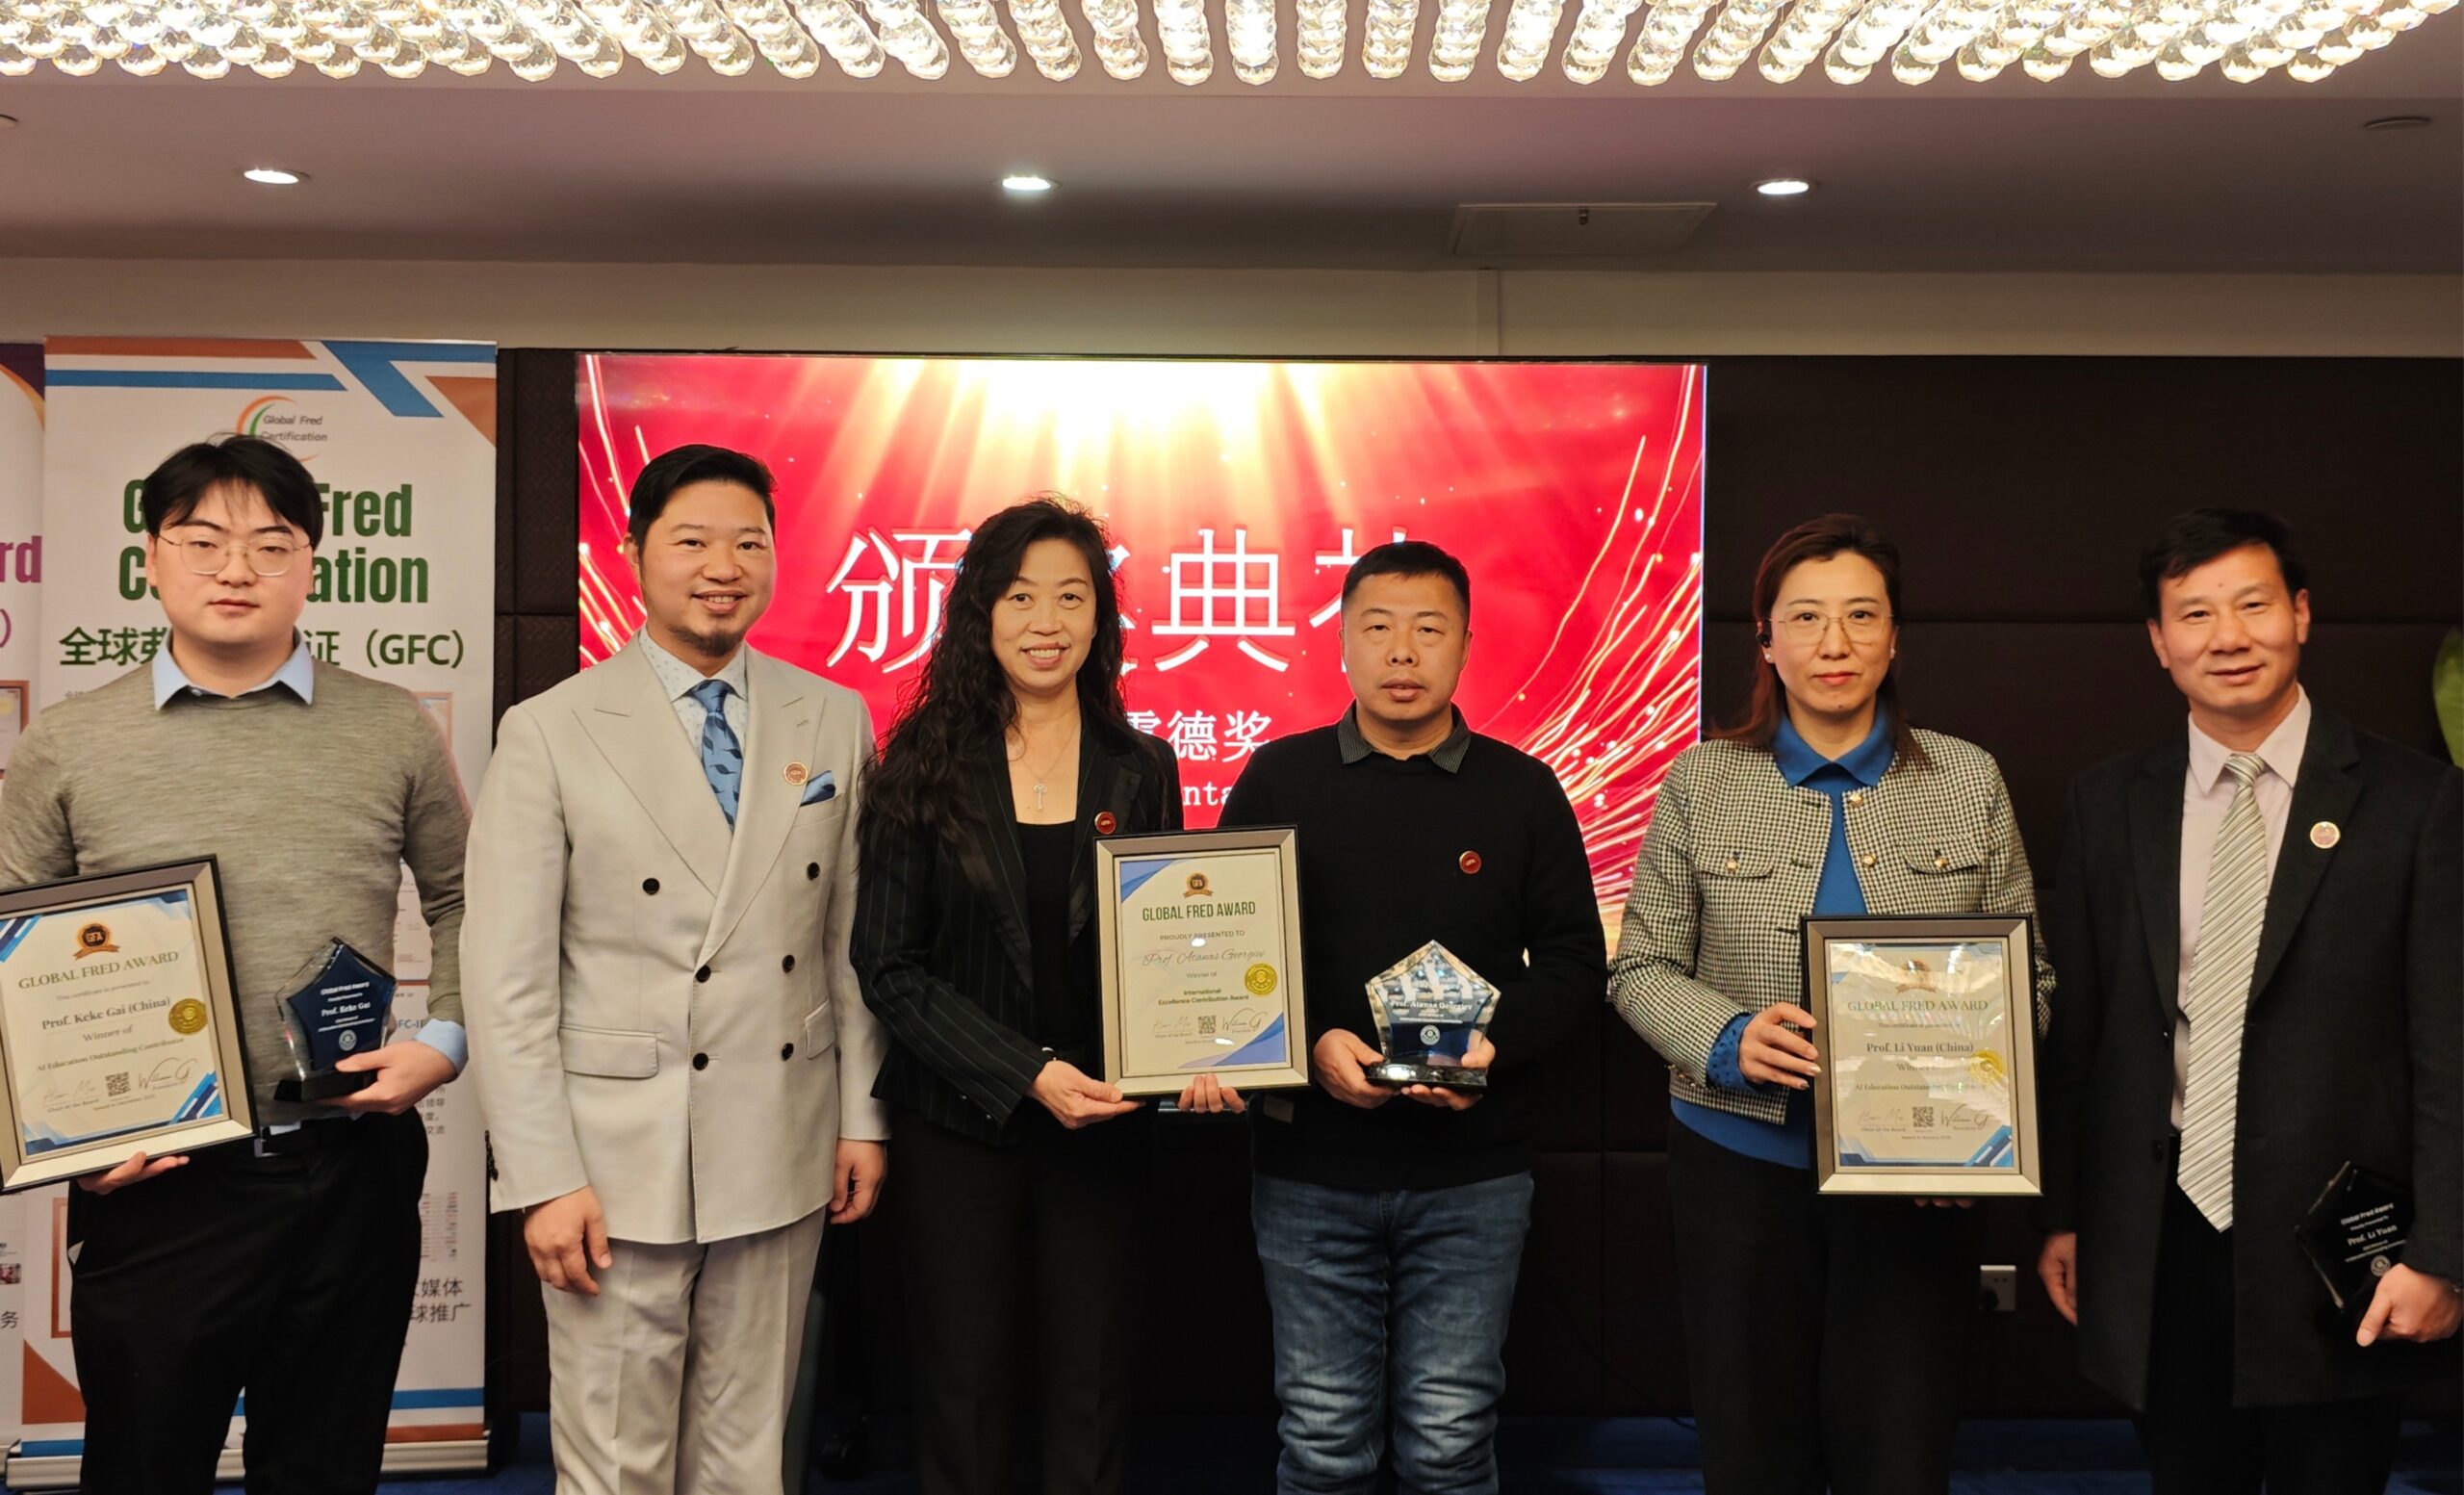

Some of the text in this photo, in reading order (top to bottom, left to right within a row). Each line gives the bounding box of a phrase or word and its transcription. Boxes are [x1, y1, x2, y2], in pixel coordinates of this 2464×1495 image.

[263, 415, 323, 425] Global Fred
[261, 431, 328, 442] Certification
[1142, 901, 1256, 921] GLOBAL FRED AWARD
[1194, 930, 1235, 940] PRESENTED
[18, 950, 179, 990] GLOBAL FRED AWARD
[1184, 988, 1222, 996] International
[1158, 997, 1191, 1006] Excellence
[1192, 995, 1229, 1004] Contribution
[1847, 999, 1989, 1012] GLOBAL FRED AWARD
[41, 997, 171, 1031] Prof. Keke Gai (China)
[321, 1006, 339, 1017] Prof.
[339, 1004, 357, 1014] Keke
[82, 1024, 134, 1043] Winner of
[1866, 1042, 1974, 1053] Prof. Li Yuan (China)
[36, 1064, 46, 1072] AI
[47, 1056, 89, 1070] Education
[89, 1045, 138, 1062] Outstanding
[2347, 1233, 2367, 1246] Prof.
[2375, 1224, 2398, 1236] Yuan
[414, 1277, 463, 1298] 媒体
